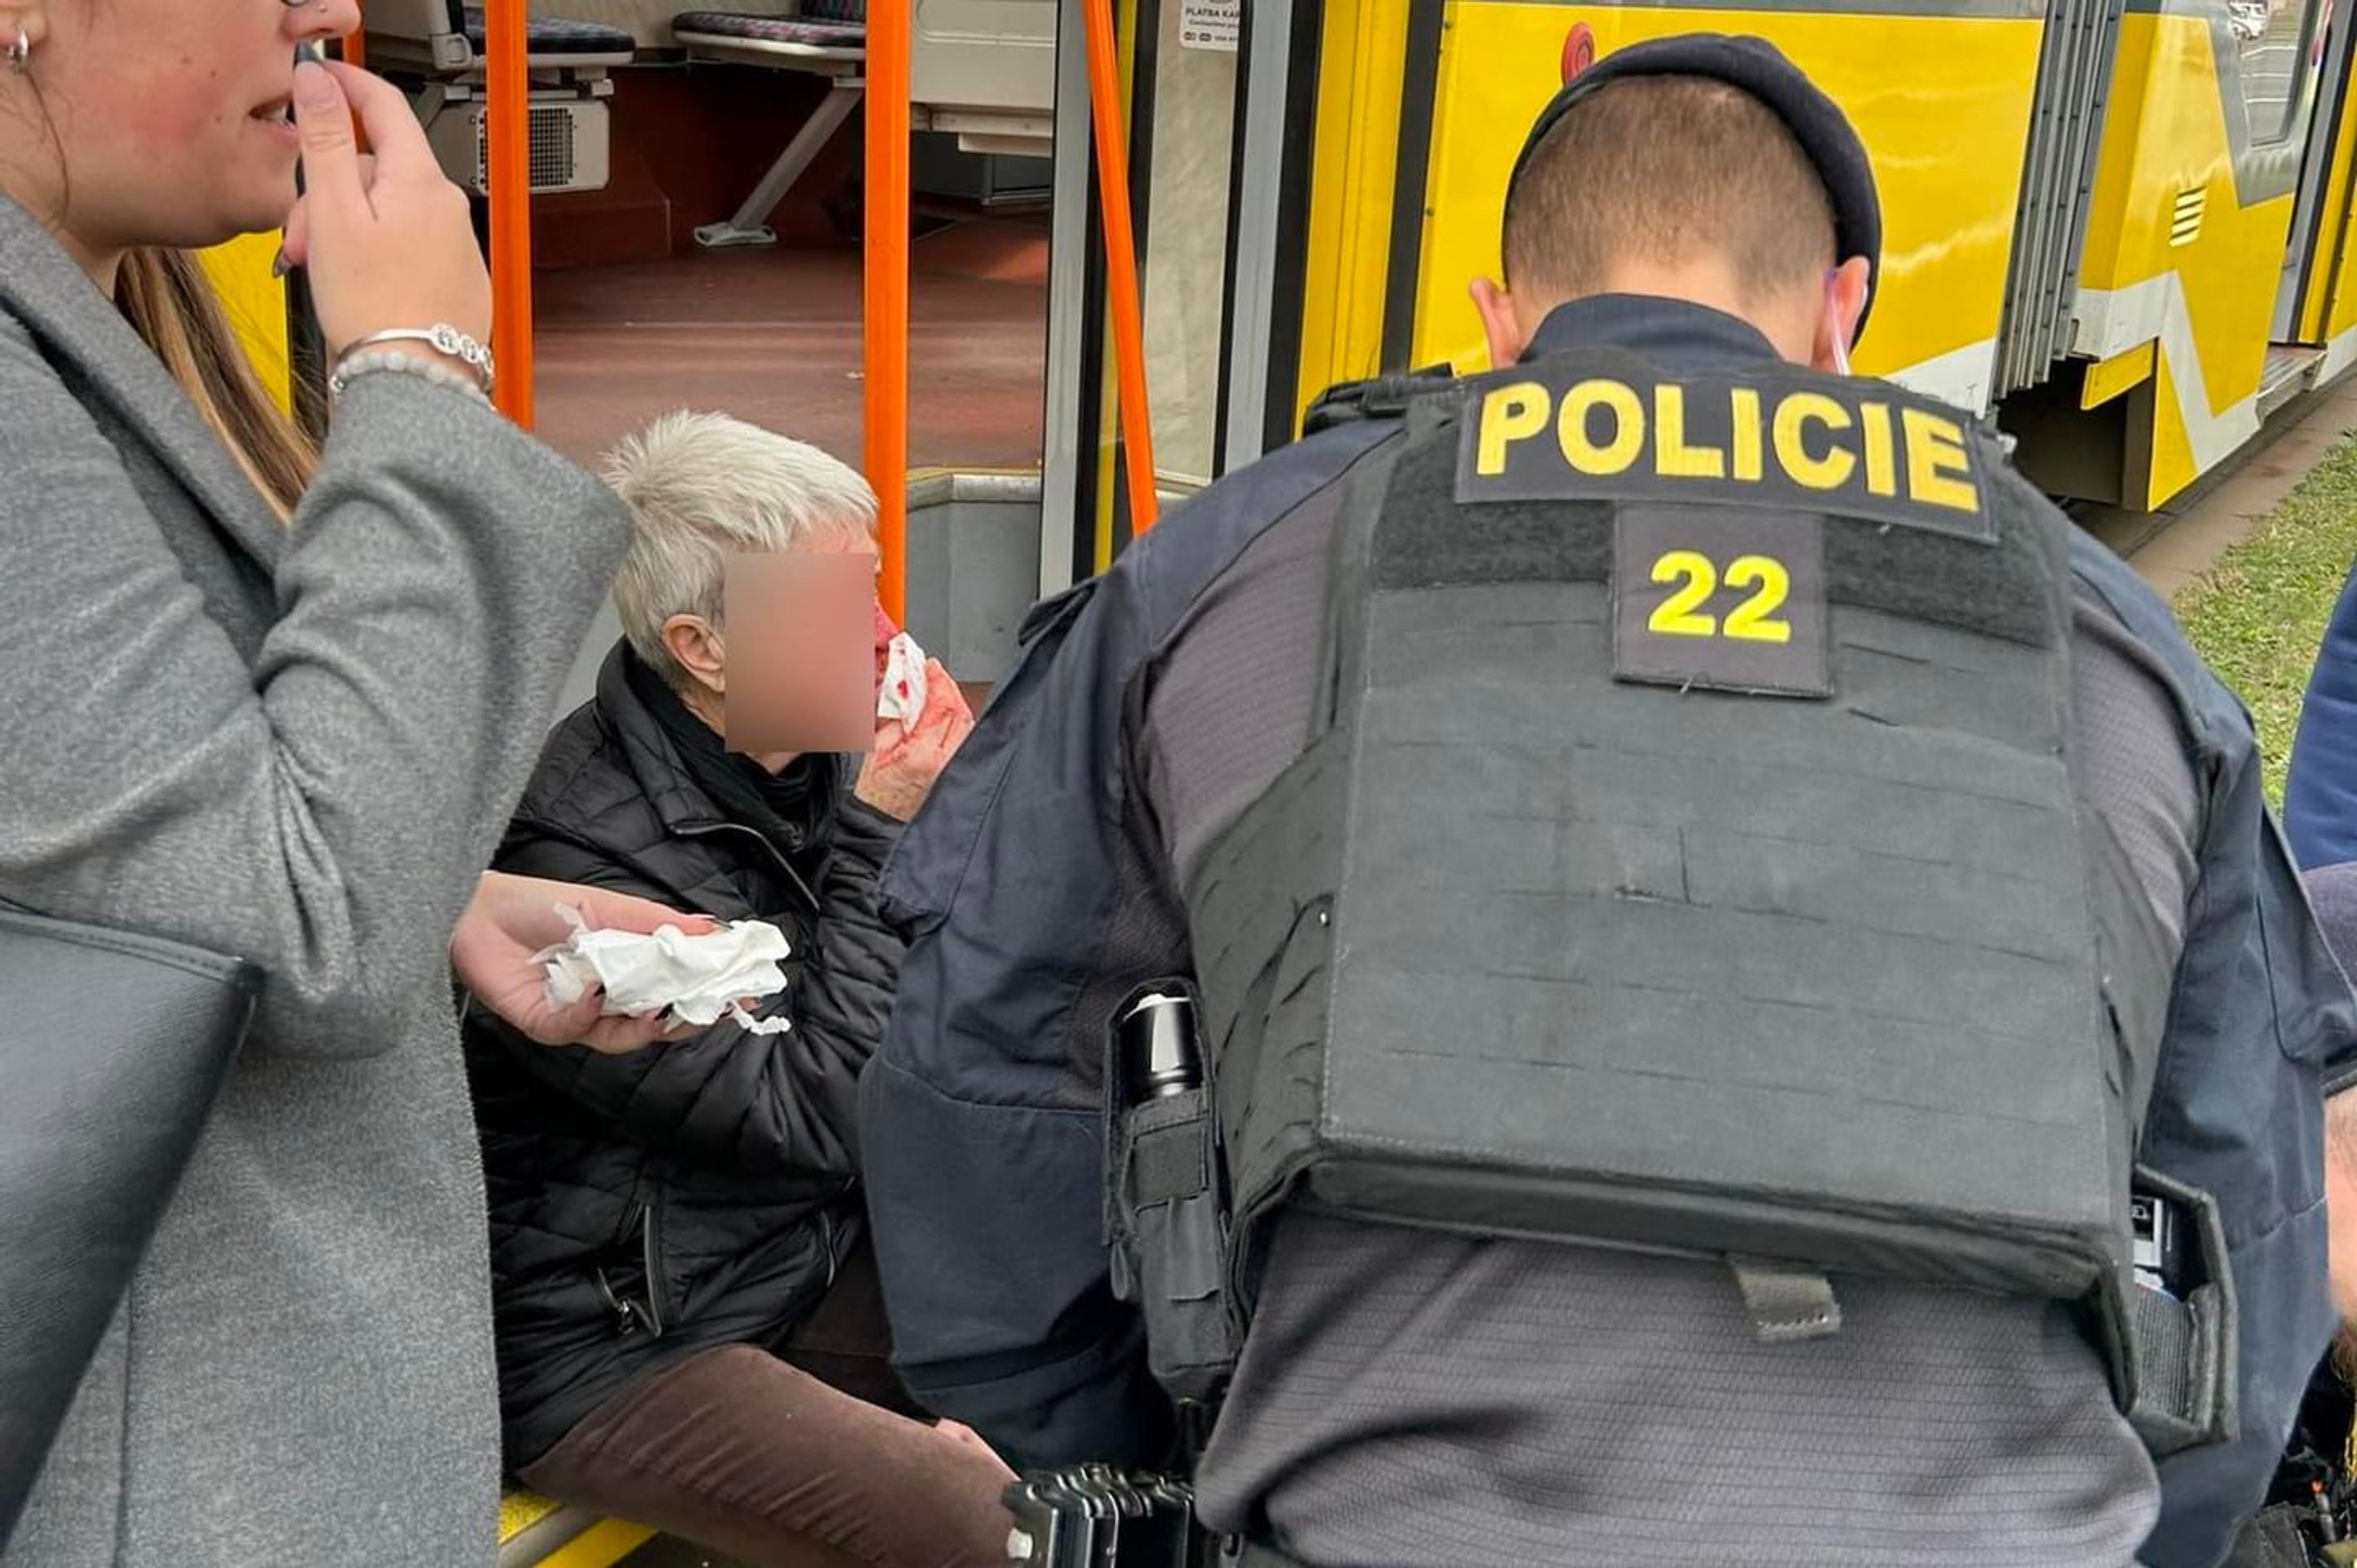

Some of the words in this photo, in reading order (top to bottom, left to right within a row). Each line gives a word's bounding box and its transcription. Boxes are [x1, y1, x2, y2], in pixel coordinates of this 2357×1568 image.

[1186, 7, 1220, 16] PLATBA
[1477, 379, 1979, 512] POLICIE
[1648, 550, 1791, 642] 22
